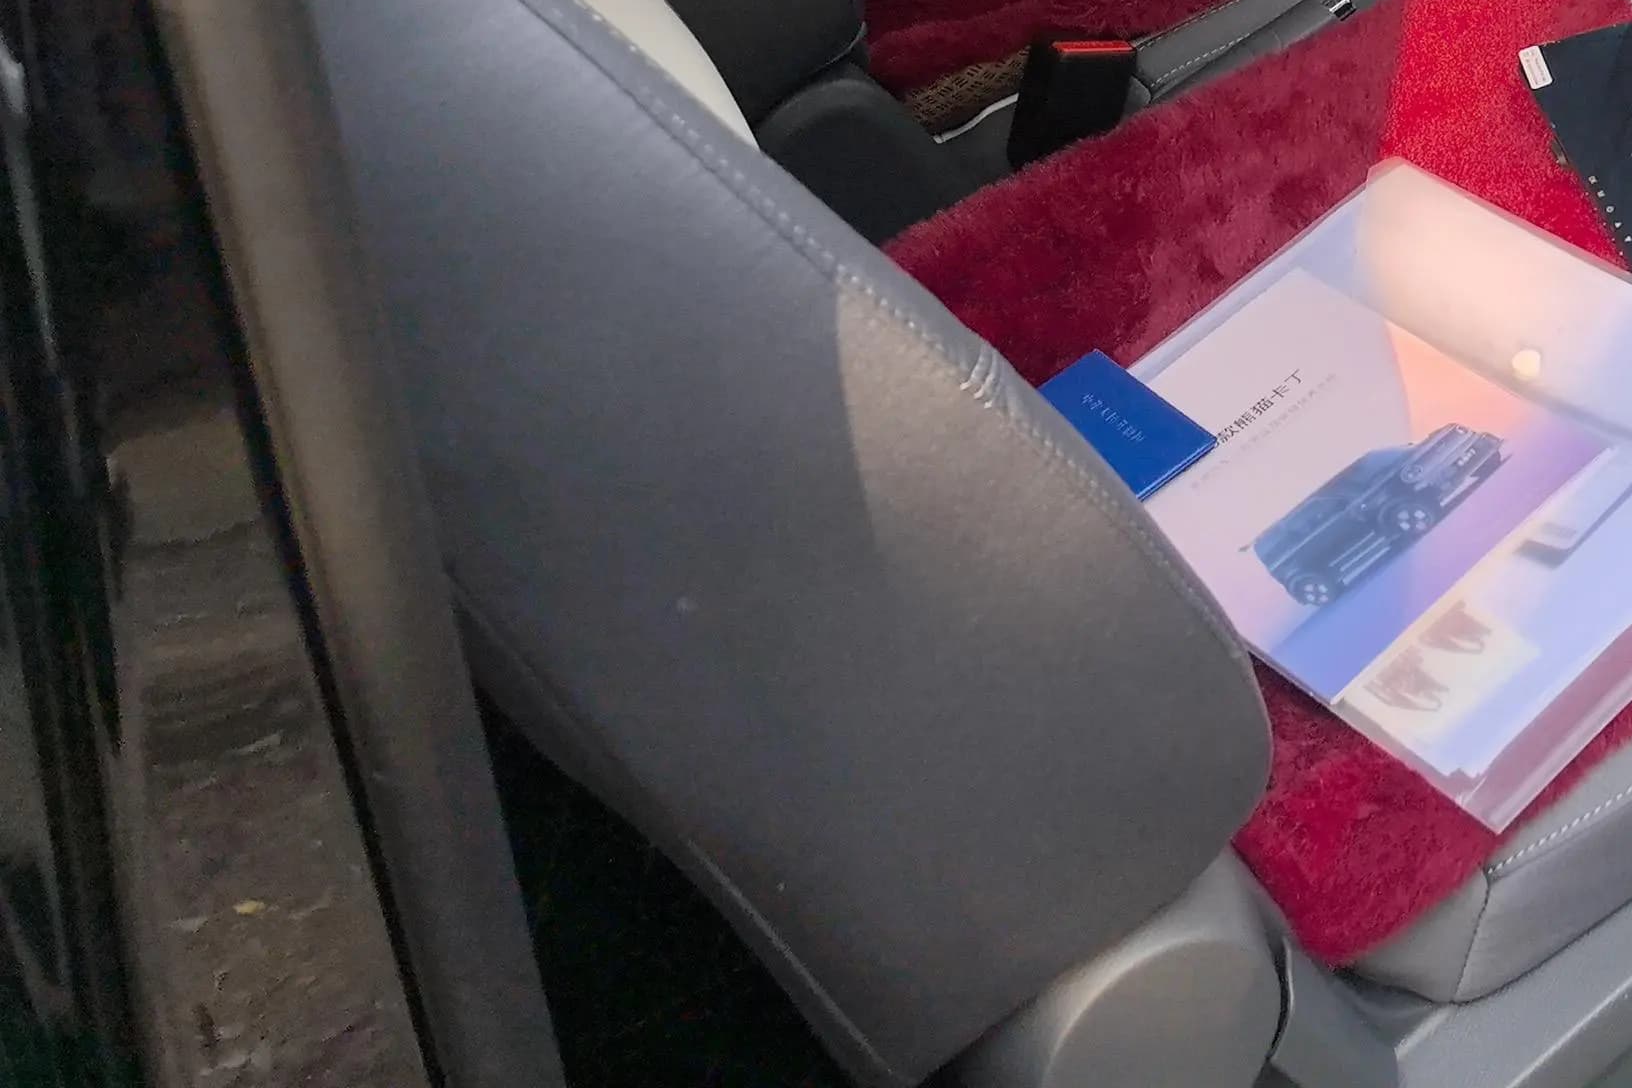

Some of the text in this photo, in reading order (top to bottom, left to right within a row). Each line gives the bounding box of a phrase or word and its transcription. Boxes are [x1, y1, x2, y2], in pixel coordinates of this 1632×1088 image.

[1213, 368, 1303, 447] 款熊猫卡丁
